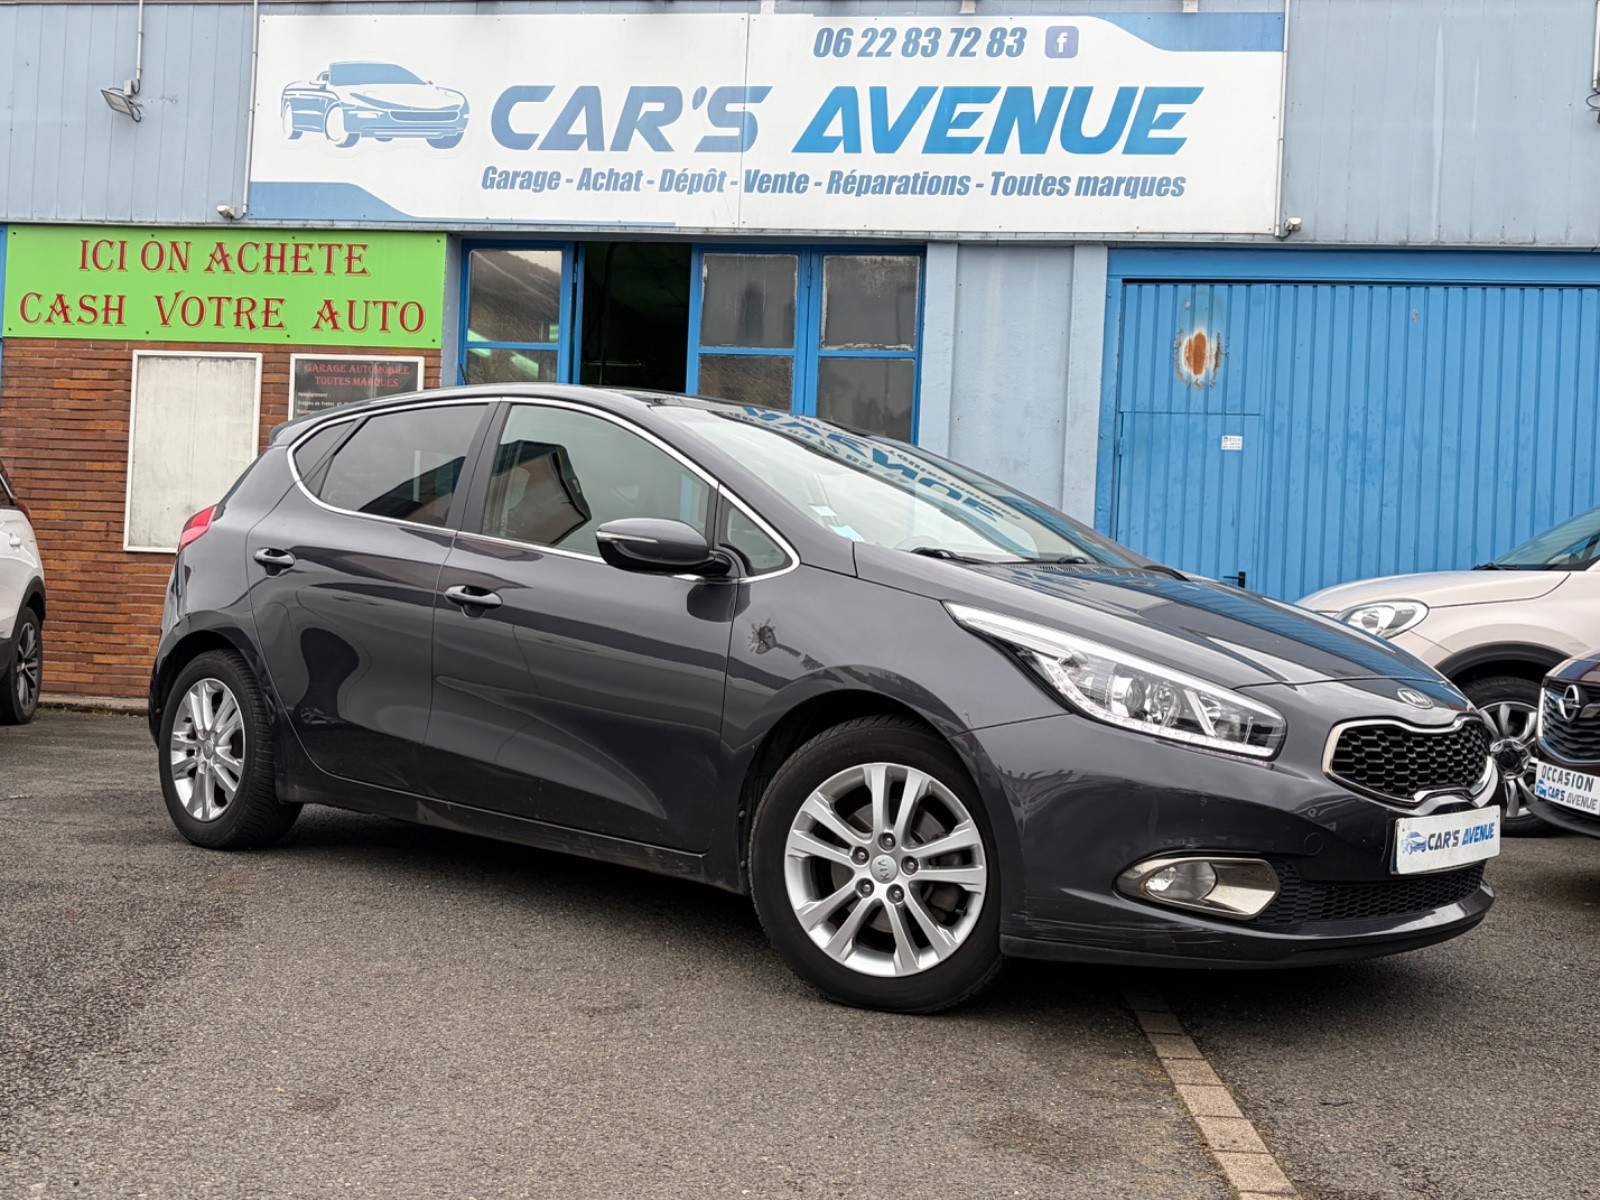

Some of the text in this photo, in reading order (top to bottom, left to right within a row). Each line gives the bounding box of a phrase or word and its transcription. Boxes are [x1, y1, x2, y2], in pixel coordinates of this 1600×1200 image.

[813, 27, 1027, 58] 06 22 83 72 83
[491, 85, 1204, 156] CAR'S AVENUE
[481, 166, 560, 193] Garage
[577, 167, 643, 192] Achat
[659, 167, 726, 195] Dépôt
[743, 169, 810, 195] Vente
[826, 169, 972, 198] Réparations
[990, 171, 1071, 197] Toutes
[1075, 174, 1186, 199] marques
[79, 239, 370, 276] ICI ON ACHETE
[19, 290, 426, 333] CASH VOTRE AUTO
[315, 376, 399, 388] TOUTES MARQUES
[349, 365, 409, 375] AUTOMOBILE
[1541, 764, 1595, 793] OCCASION
[1566, 792, 1599, 811] AVENUE
[1428, 821, 1495, 851] CAR'S AVENUE
